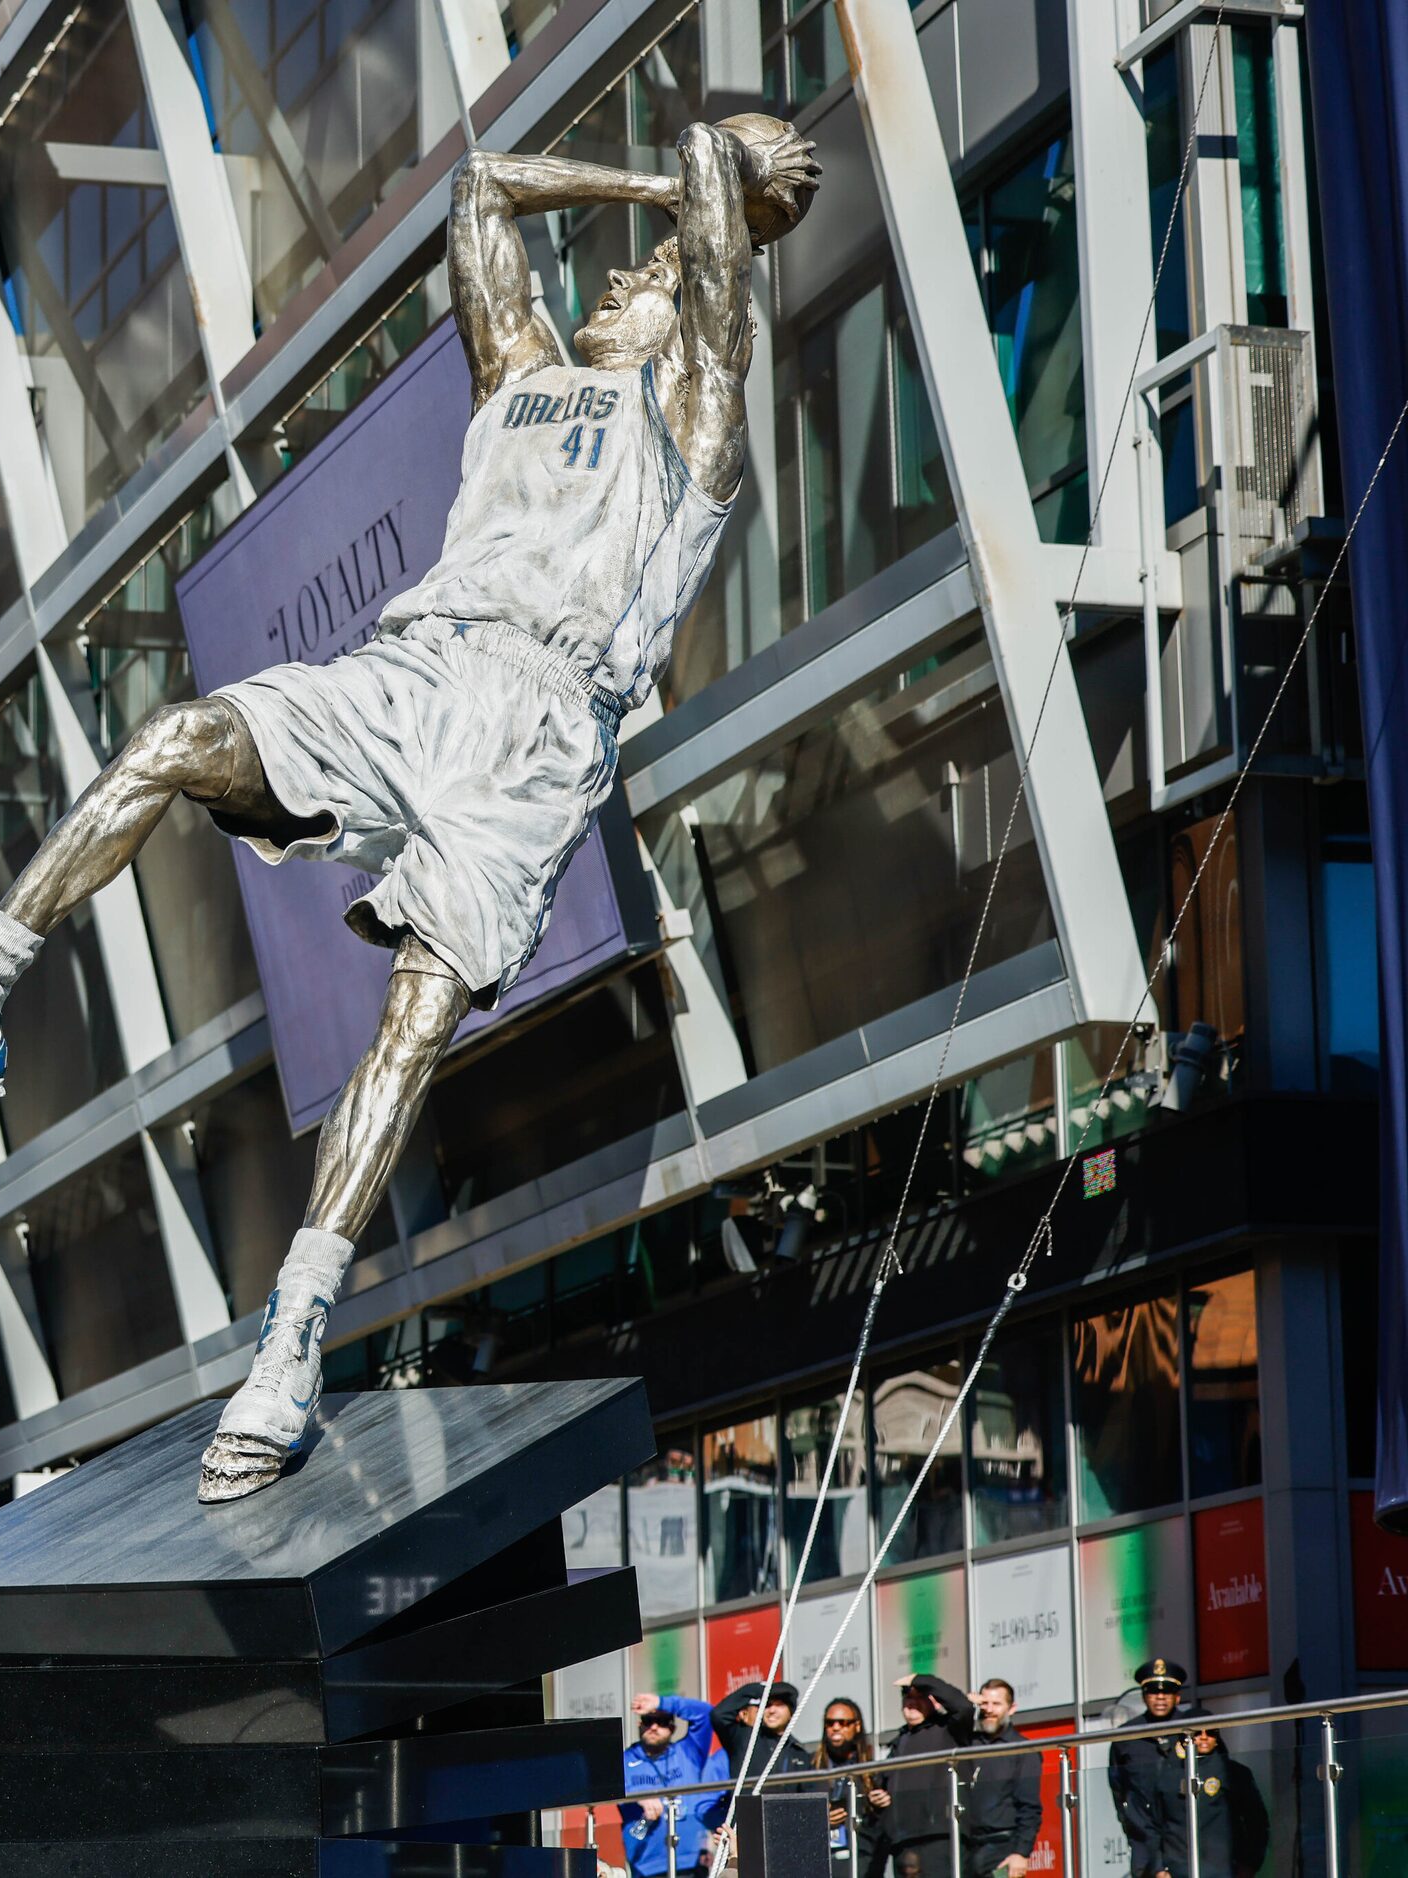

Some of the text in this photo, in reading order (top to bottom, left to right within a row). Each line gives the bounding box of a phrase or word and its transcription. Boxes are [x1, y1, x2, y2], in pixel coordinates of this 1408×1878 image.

[502, 386, 621, 430] DALLAS
[559, 422, 607, 471] 41
[1206, 1573, 1263, 1611] Available
